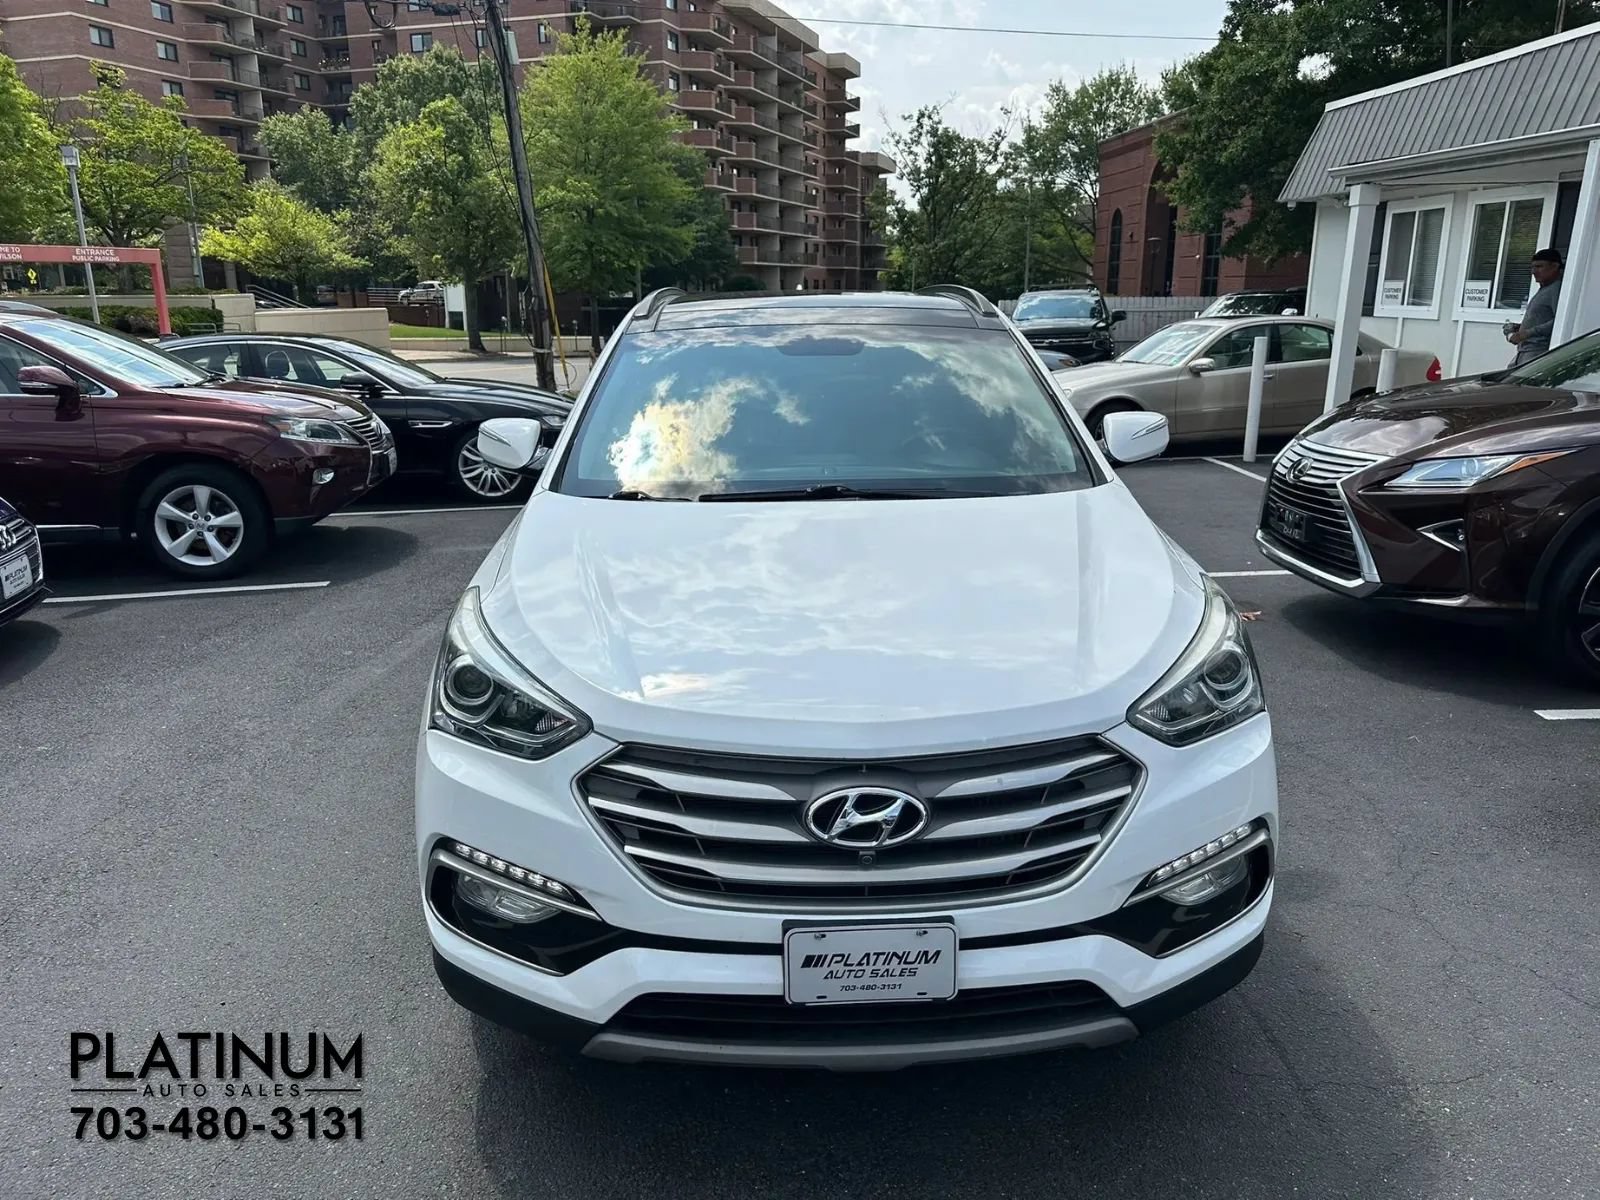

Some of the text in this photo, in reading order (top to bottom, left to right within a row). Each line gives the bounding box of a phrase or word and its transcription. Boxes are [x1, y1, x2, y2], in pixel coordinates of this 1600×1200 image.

[75, 248, 115, 256] ENTRANCE
[827, 950, 942, 968] PLATINUM
[823, 967, 918, 980] AUTO SALES
[839, 983, 903, 992] 703-480-3131
